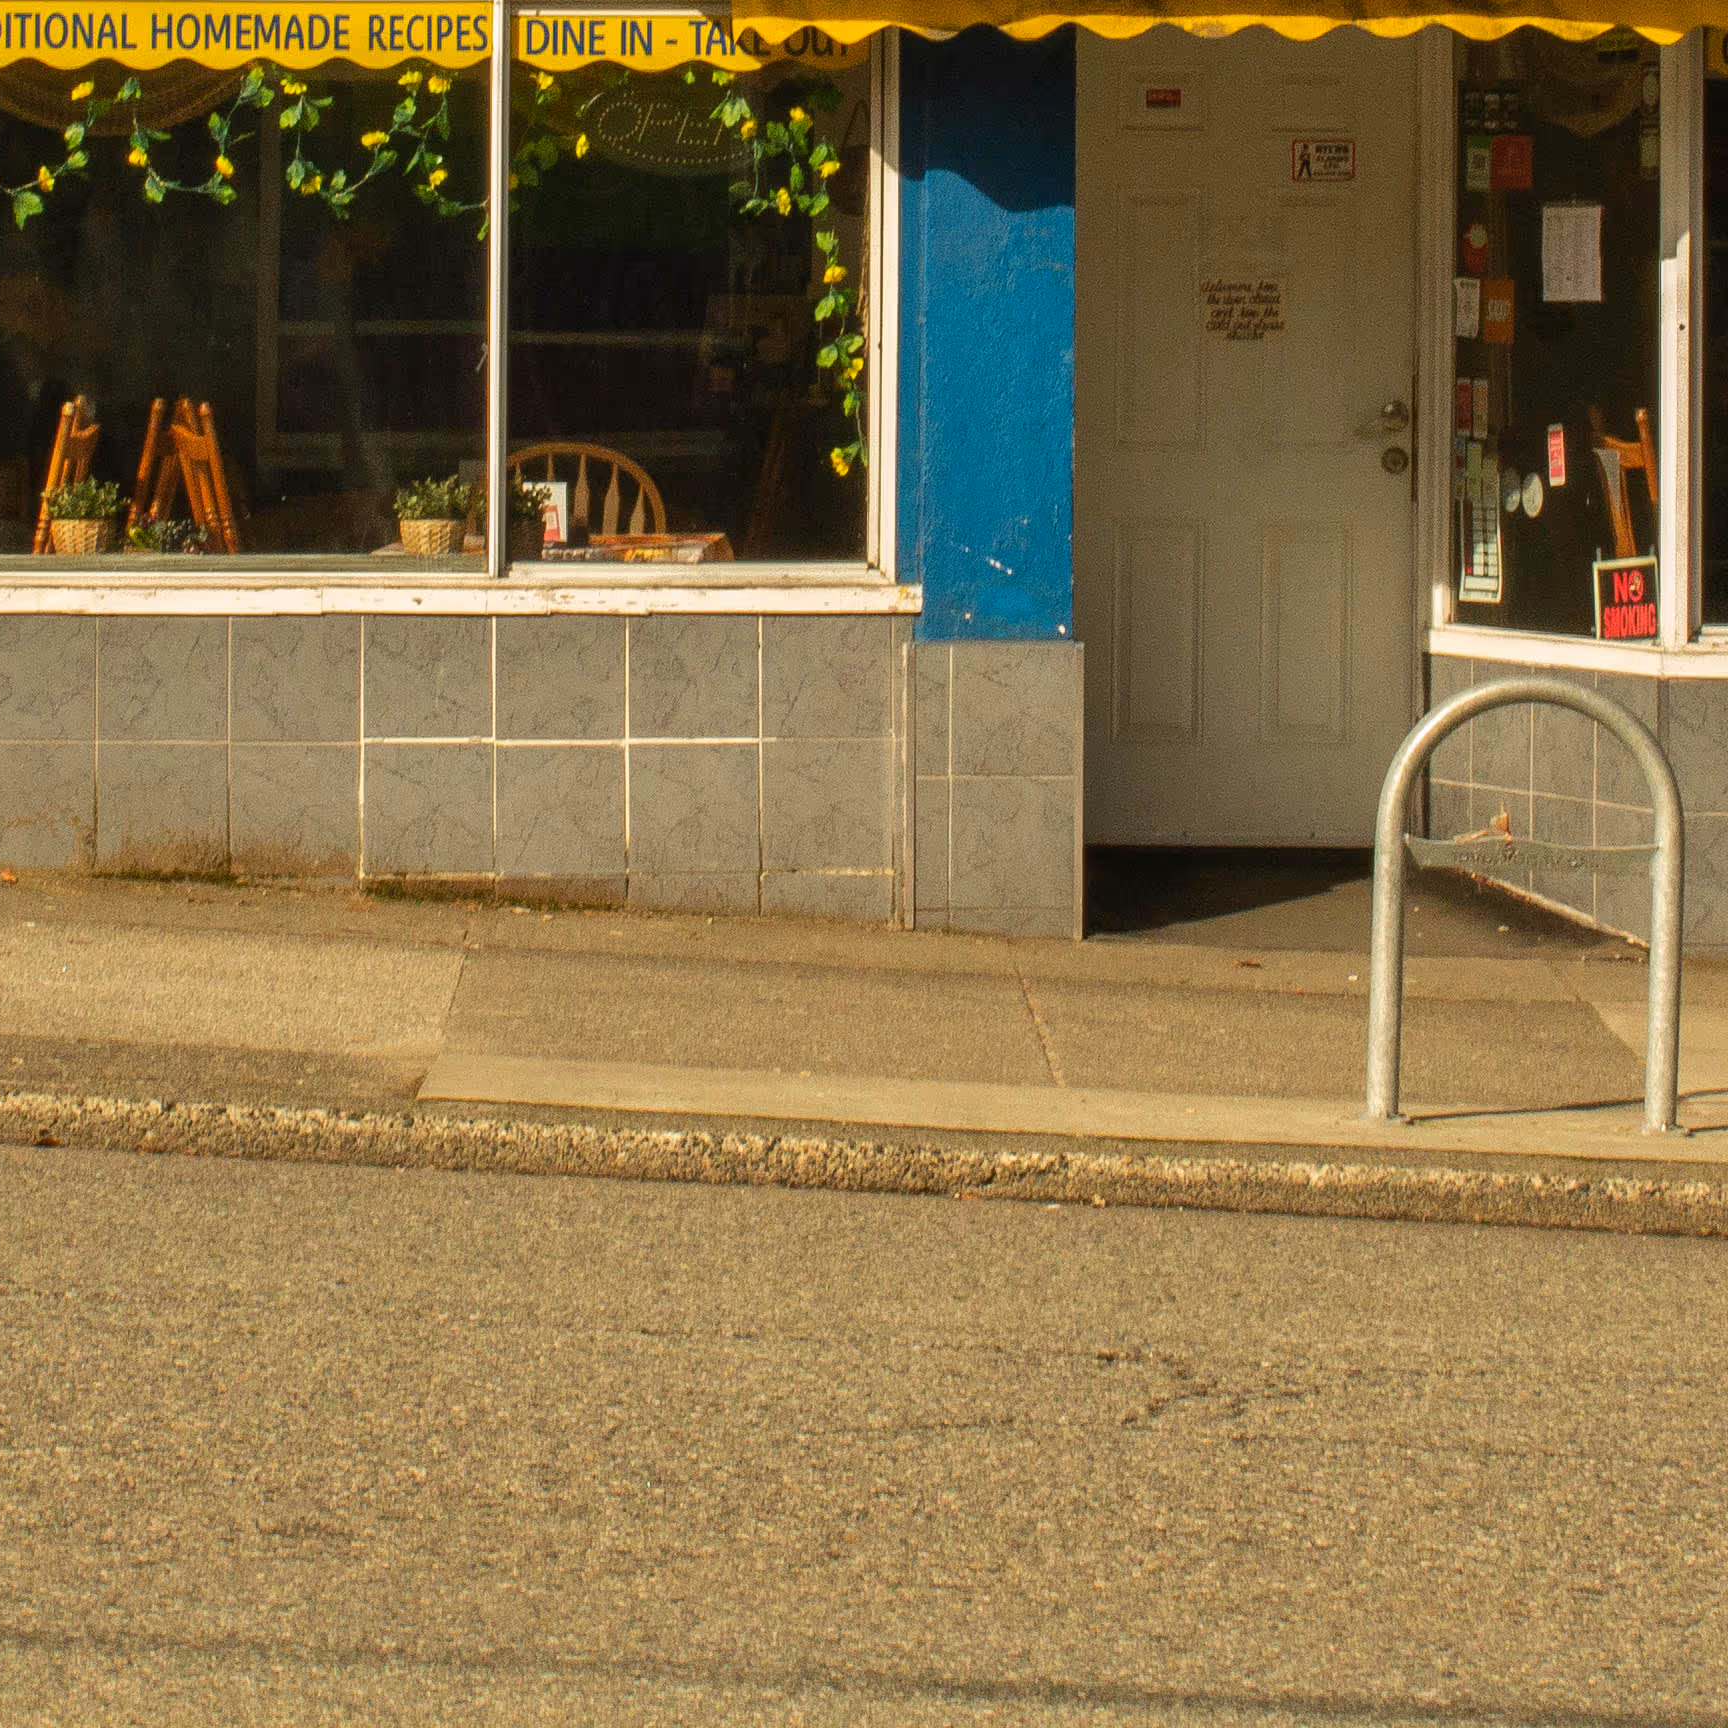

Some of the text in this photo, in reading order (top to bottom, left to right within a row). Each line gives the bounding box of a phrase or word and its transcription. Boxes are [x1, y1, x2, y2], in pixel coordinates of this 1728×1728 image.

[151, 13, 351, 51] HOMEMADE
[369, 14, 489, 53] RECIPES
[526, 19, 606, 56] DINE
[620, 20, 653, 56] IN
[1613, 569, 1645, 603] NO
[1603, 603, 1657, 639] SMOKING
